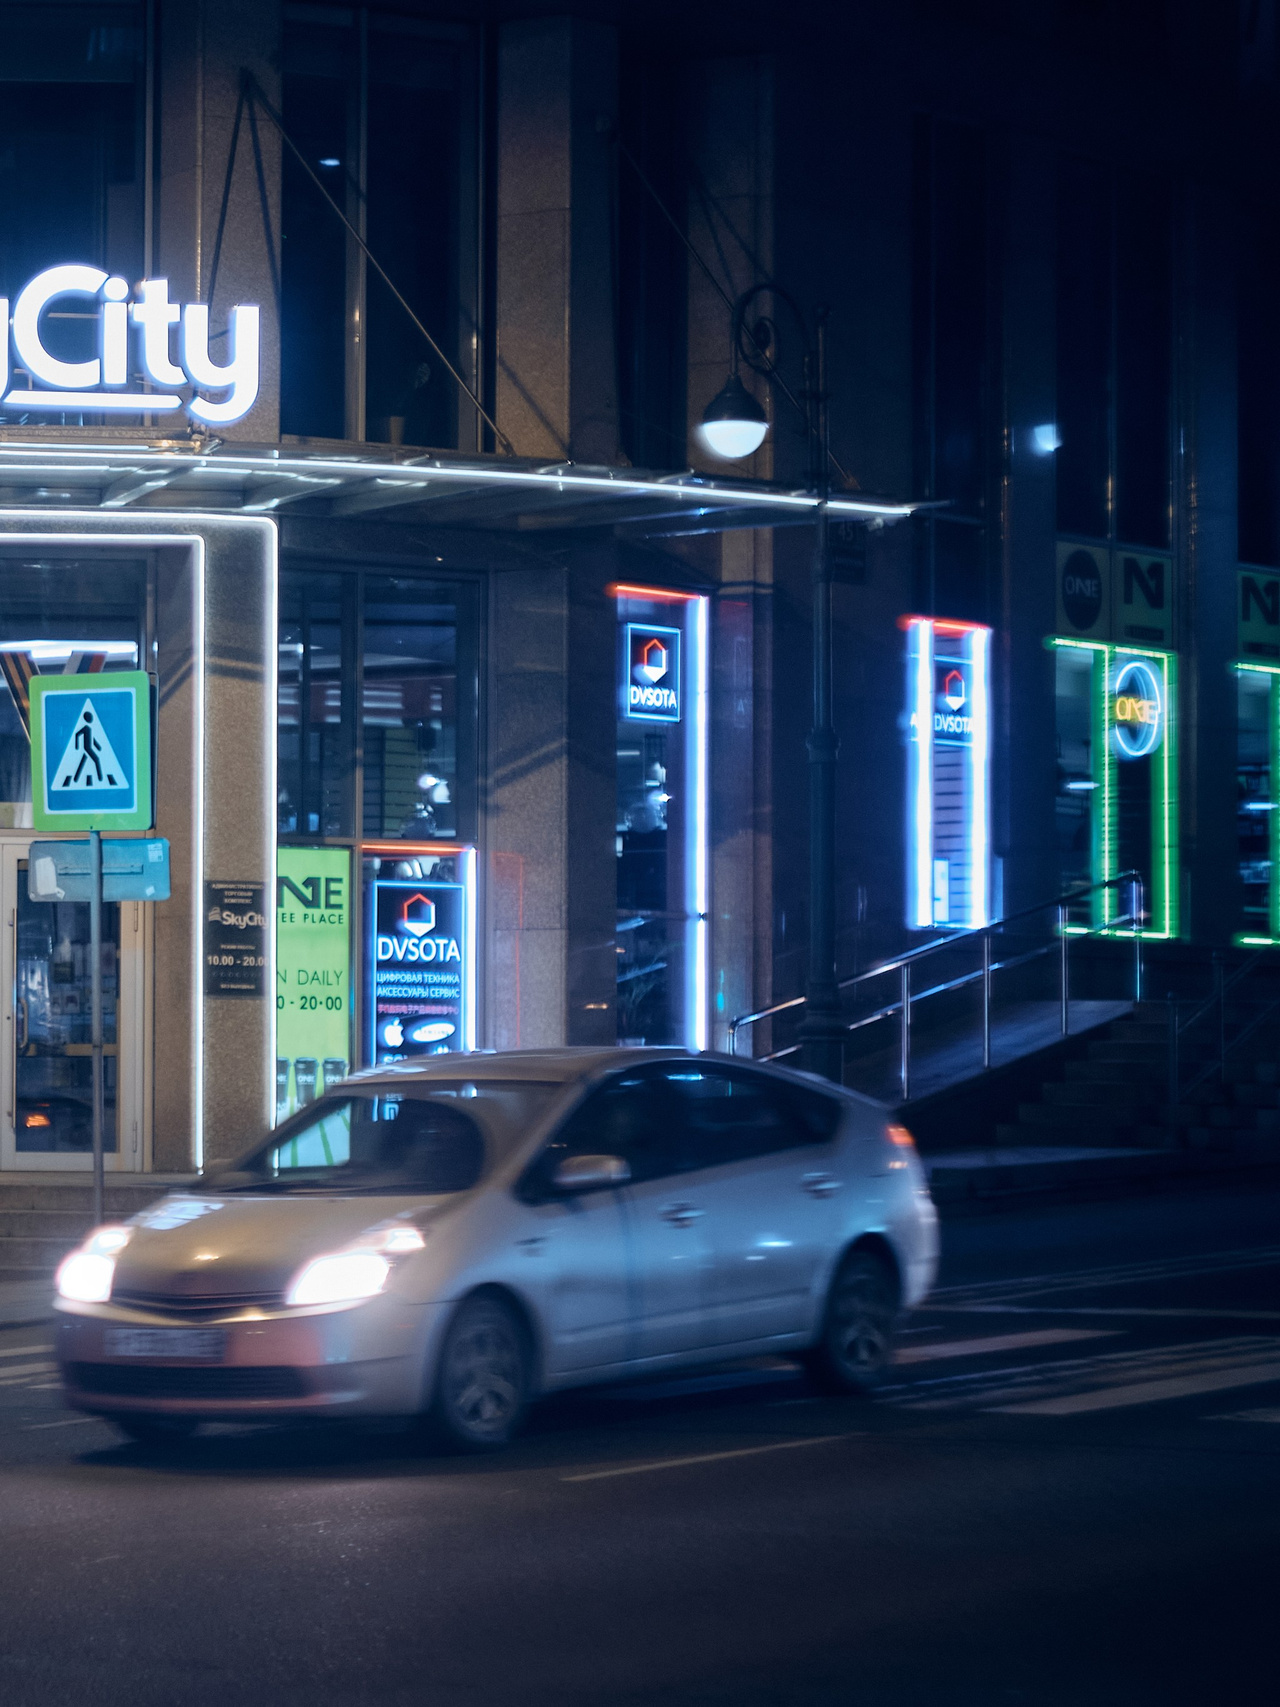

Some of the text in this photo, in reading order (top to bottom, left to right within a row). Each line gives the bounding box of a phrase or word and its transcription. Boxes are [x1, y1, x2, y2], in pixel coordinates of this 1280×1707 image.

[630, 685, 678, 709] DVSOTA
[303, 913, 344, 924] PLACE
[377, 935, 461, 963] DVSOTA
[207, 955, 235, 966] 10.00
[297, 969, 344, 986] DAILY
[376, 972, 460, 985] ЦИФРОВАЯ ТЕХНИКА
[376, 986, 461, 999] АКСЕССУАРЫ СЕРВИС
